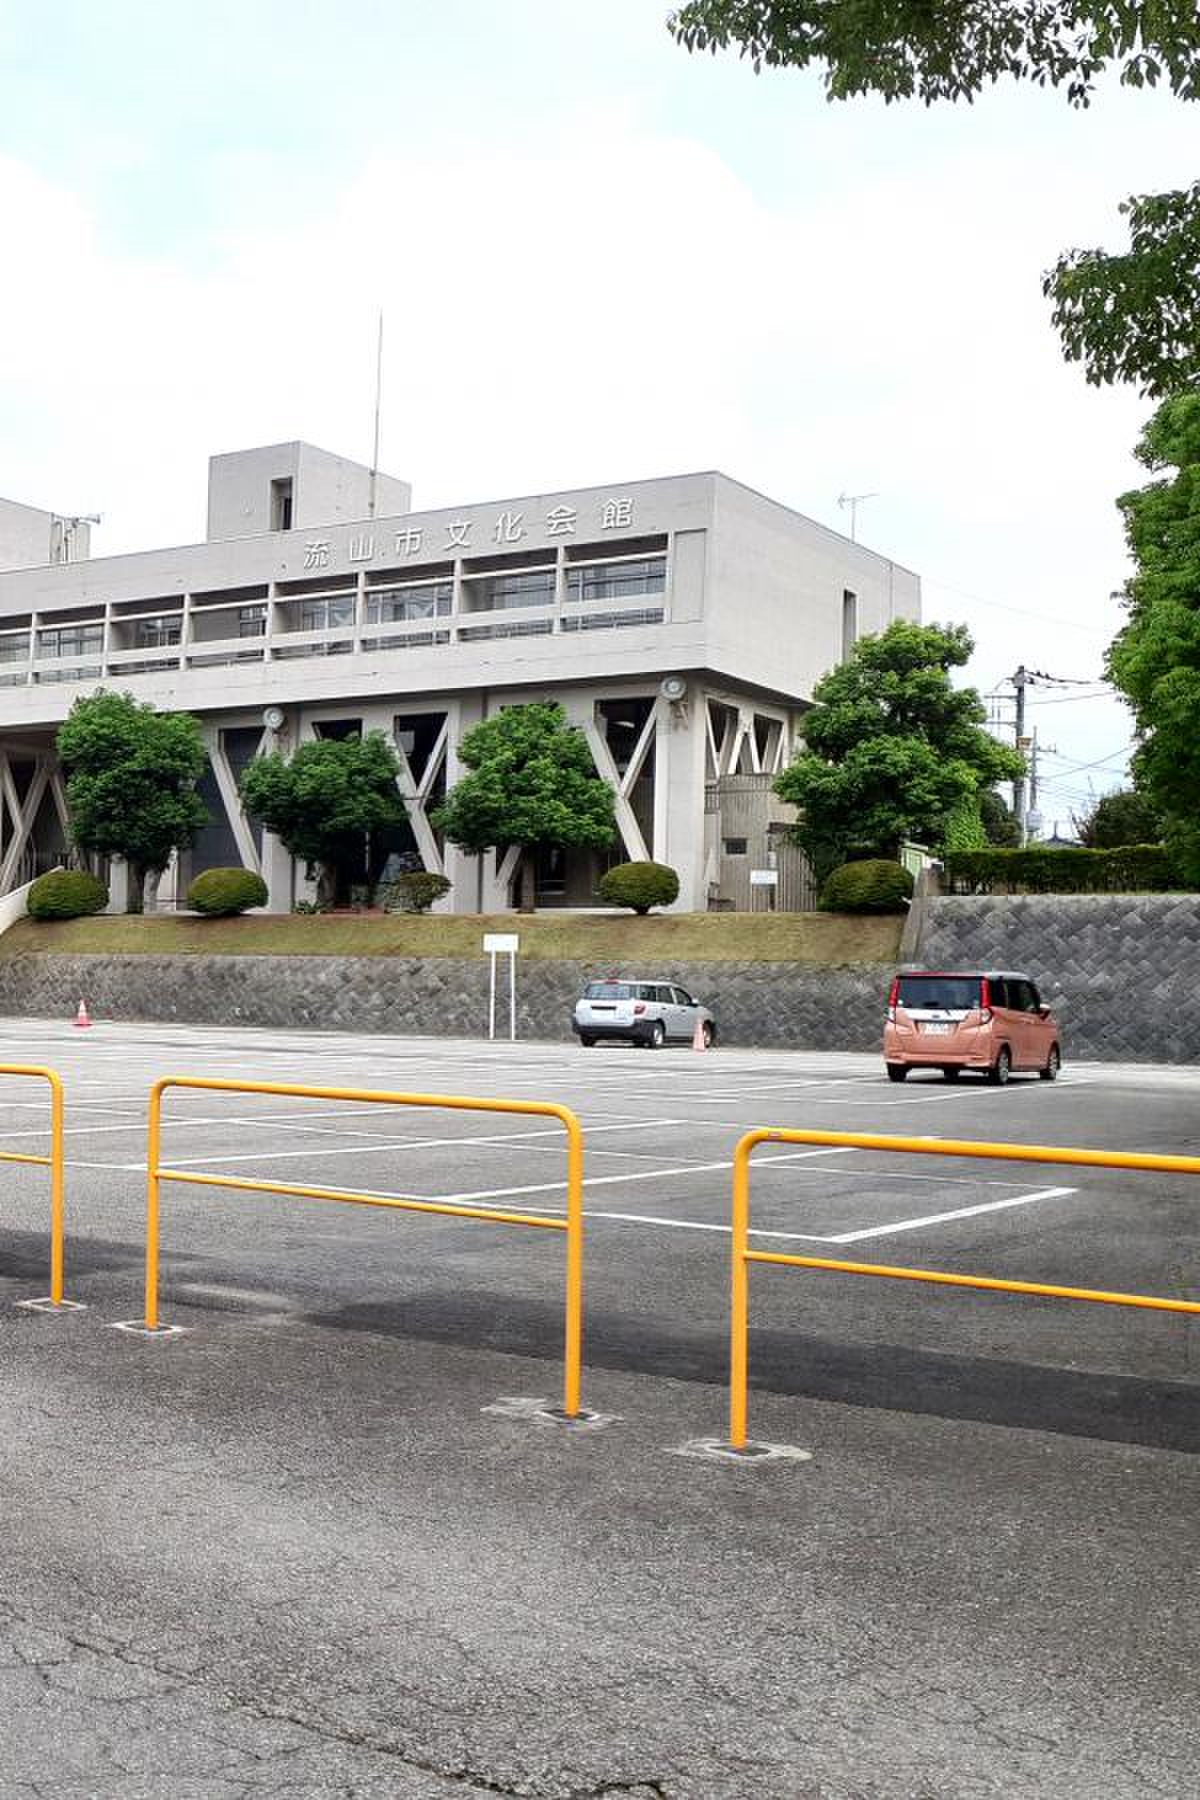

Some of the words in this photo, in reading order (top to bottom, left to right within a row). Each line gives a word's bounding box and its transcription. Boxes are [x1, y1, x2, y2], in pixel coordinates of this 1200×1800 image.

[303, 497, 634, 569] 流山市文化会館
